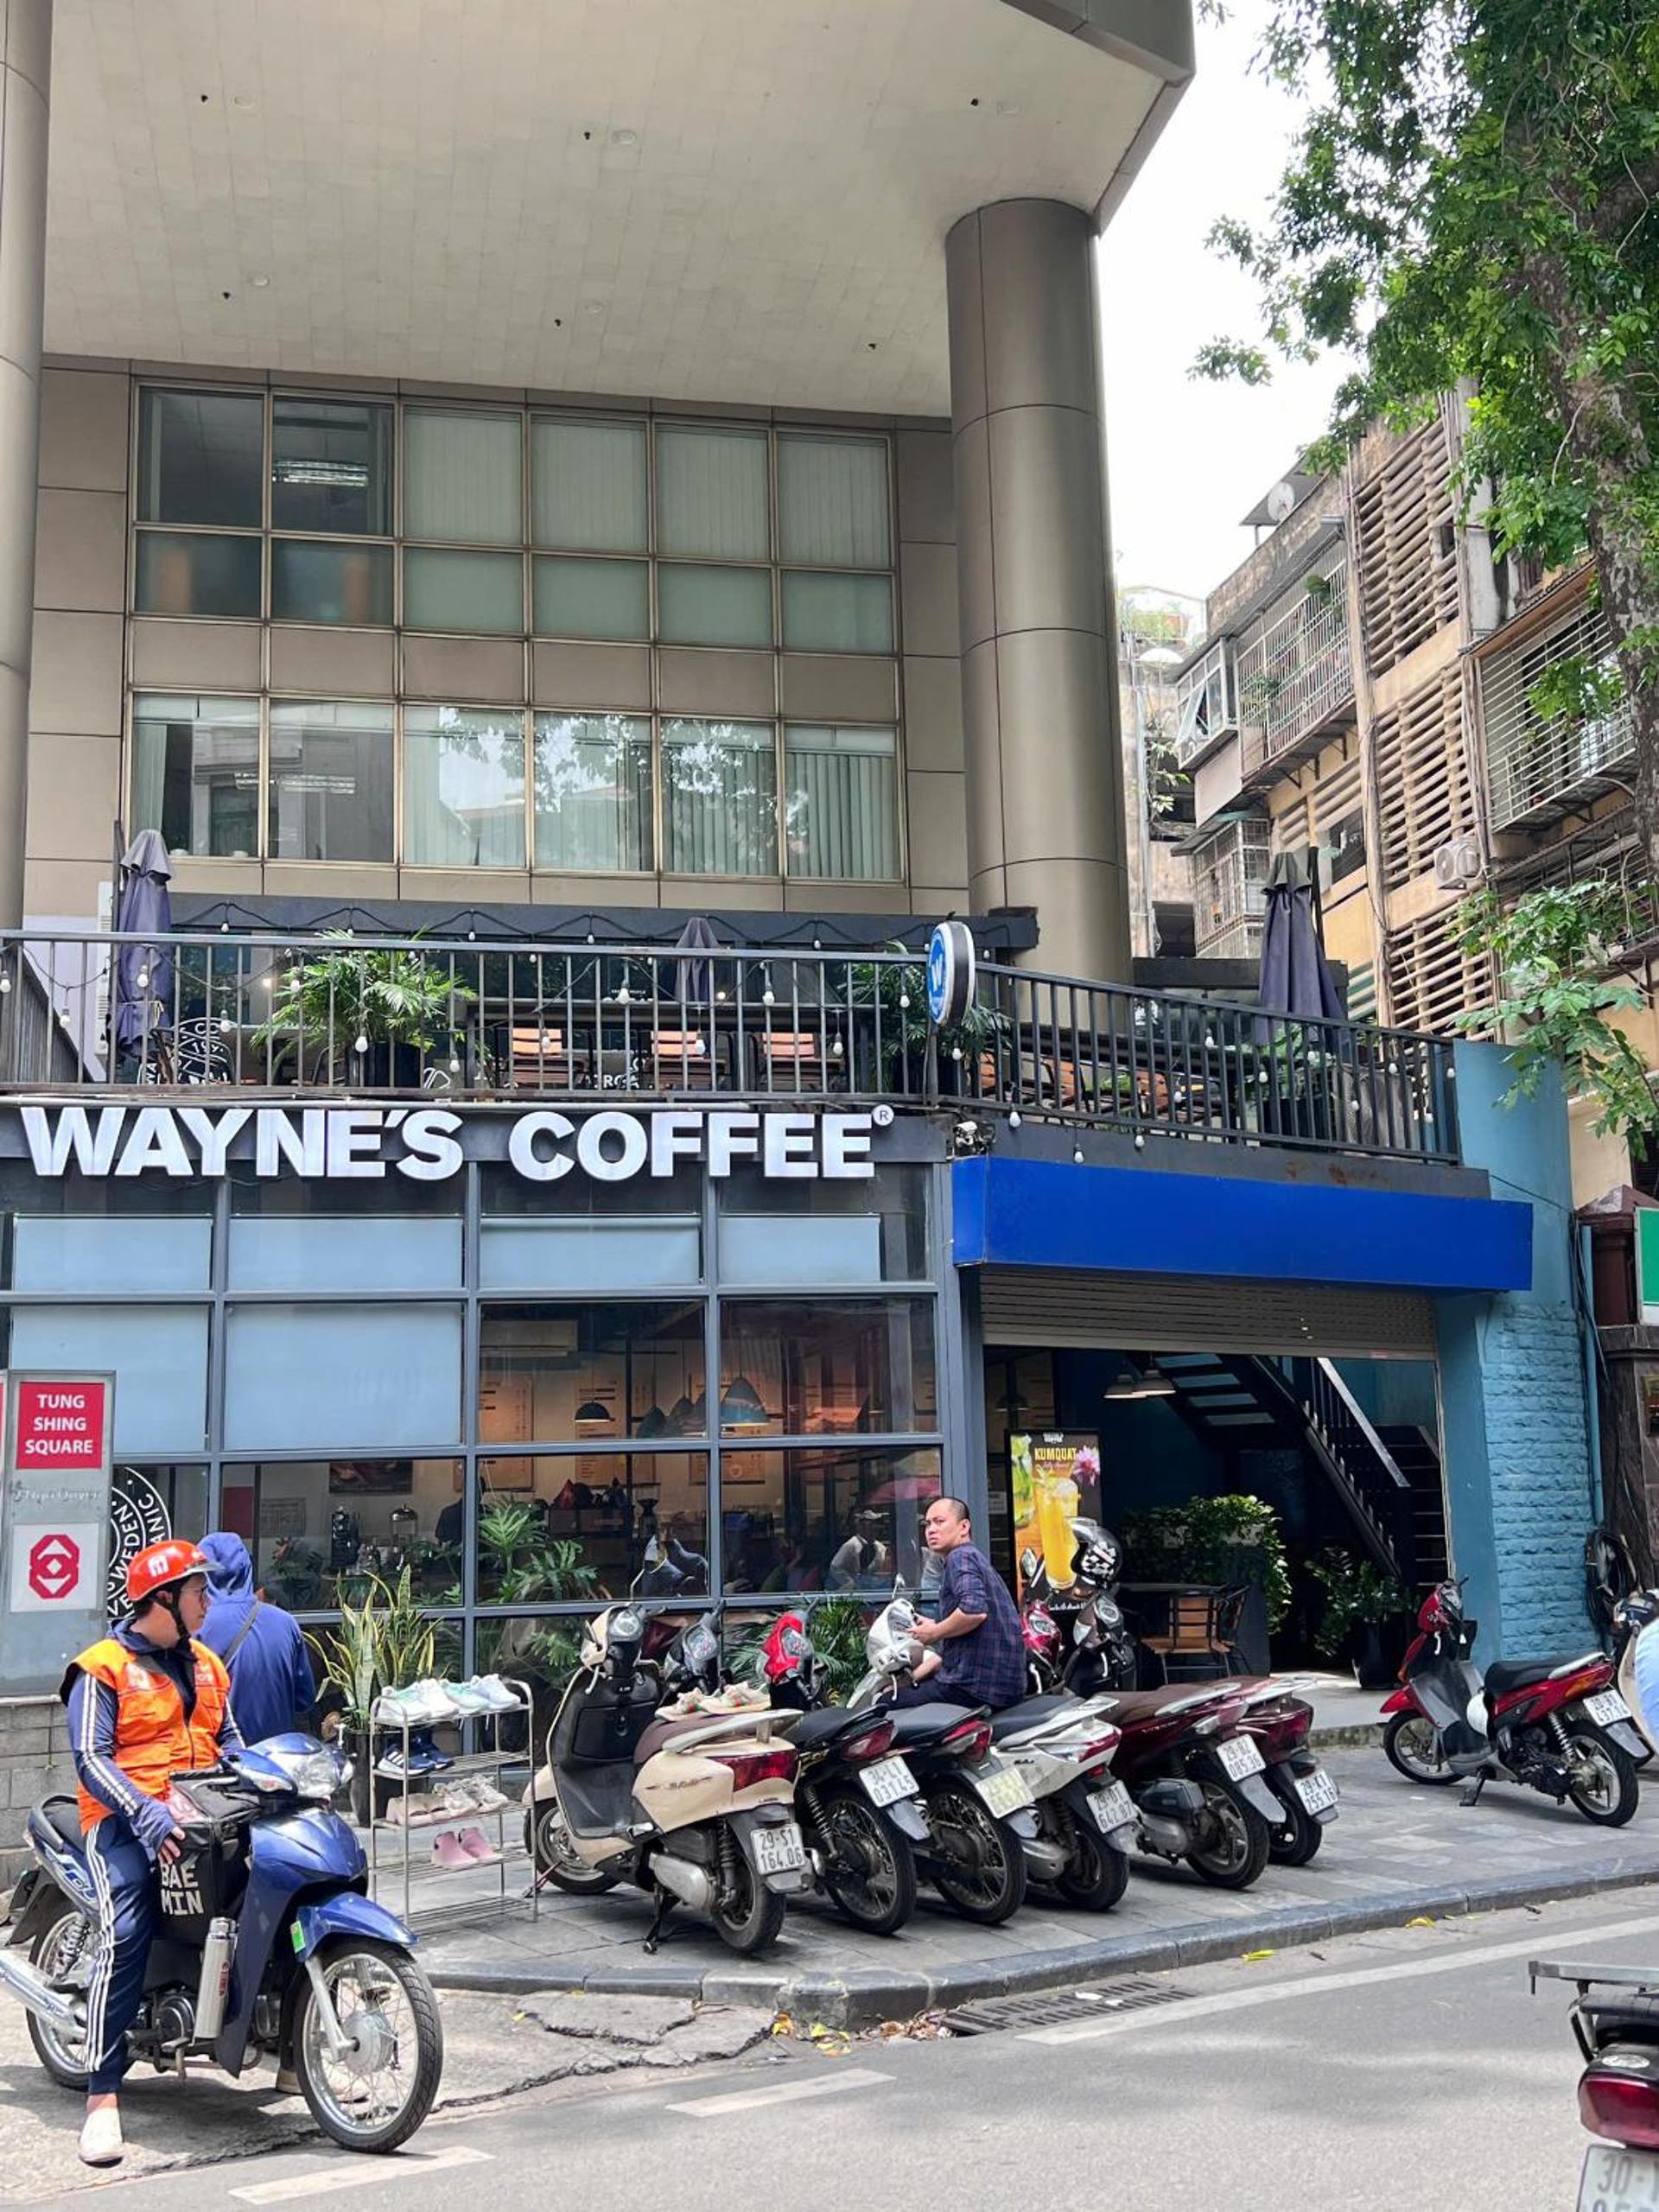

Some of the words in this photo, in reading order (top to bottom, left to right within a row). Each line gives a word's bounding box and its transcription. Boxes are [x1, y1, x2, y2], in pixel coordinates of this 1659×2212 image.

[20, 1106, 464, 1181] WAYNE'S
[508, 1110, 875, 1181] COFFEE
[37, 1394, 86, 1408] TUNG
[33, 1416, 87, 1432] SHING
[25, 1440, 93, 1455] SQUARE
[1034, 1447, 1077, 1461] KUMQUAT
[760, 1847, 804, 1872] 164.06
[159, 1863, 199, 1889] BAE
[161, 1888, 204, 1916] MIN
